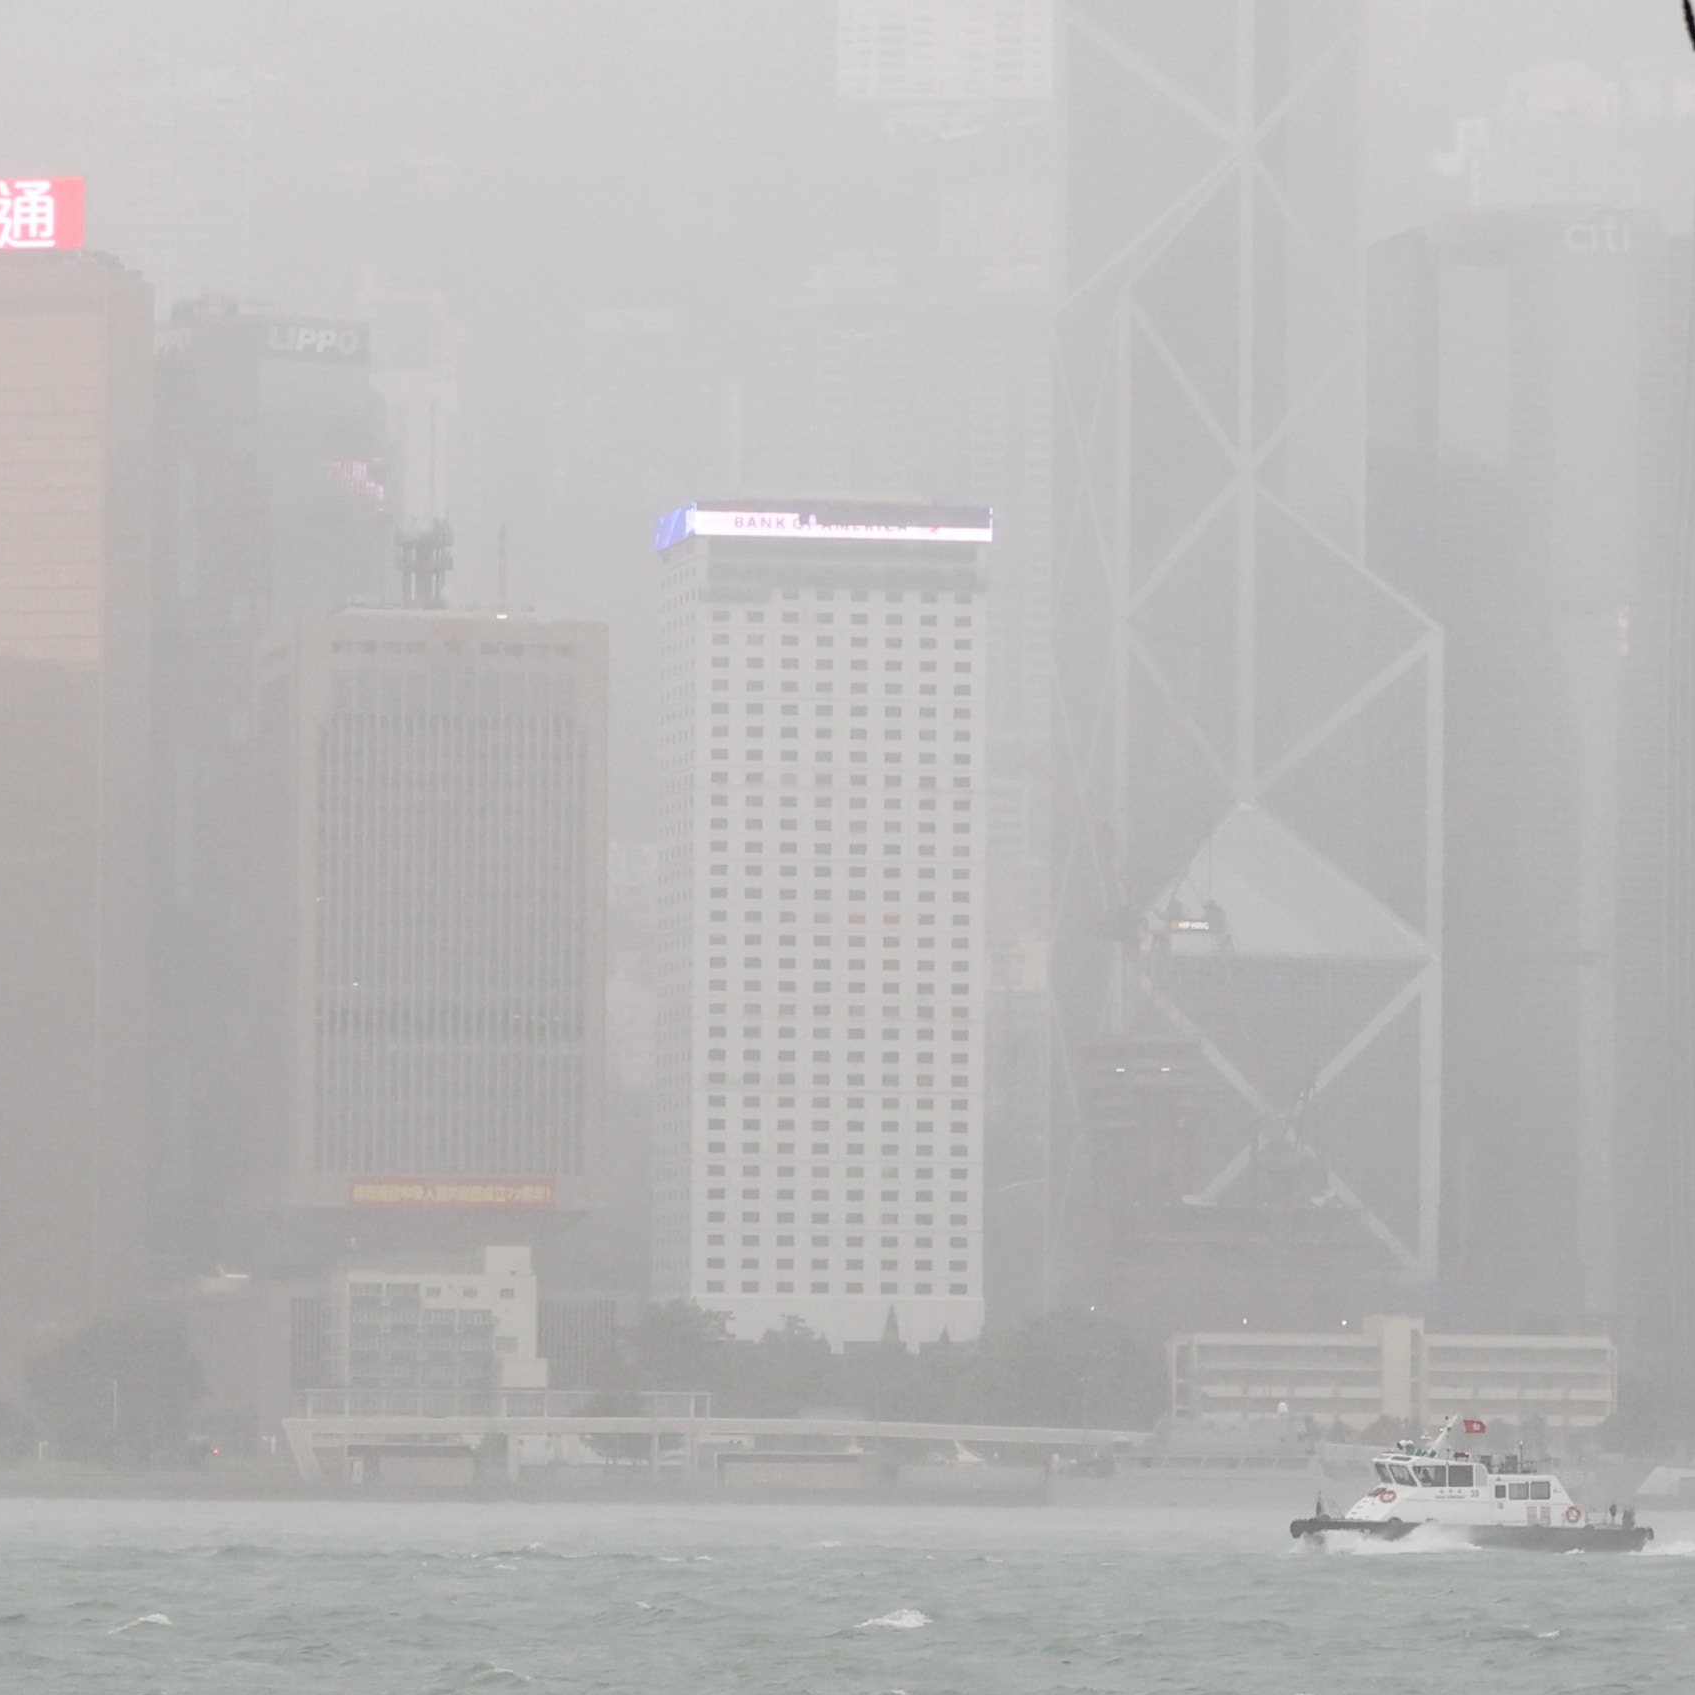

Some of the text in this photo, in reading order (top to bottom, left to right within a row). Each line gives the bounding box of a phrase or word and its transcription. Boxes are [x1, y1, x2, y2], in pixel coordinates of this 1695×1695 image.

[1565, 216, 1632, 252] citi
[268, 325, 359, 356] LIPPO
[734, 516, 786, 530] BANK
